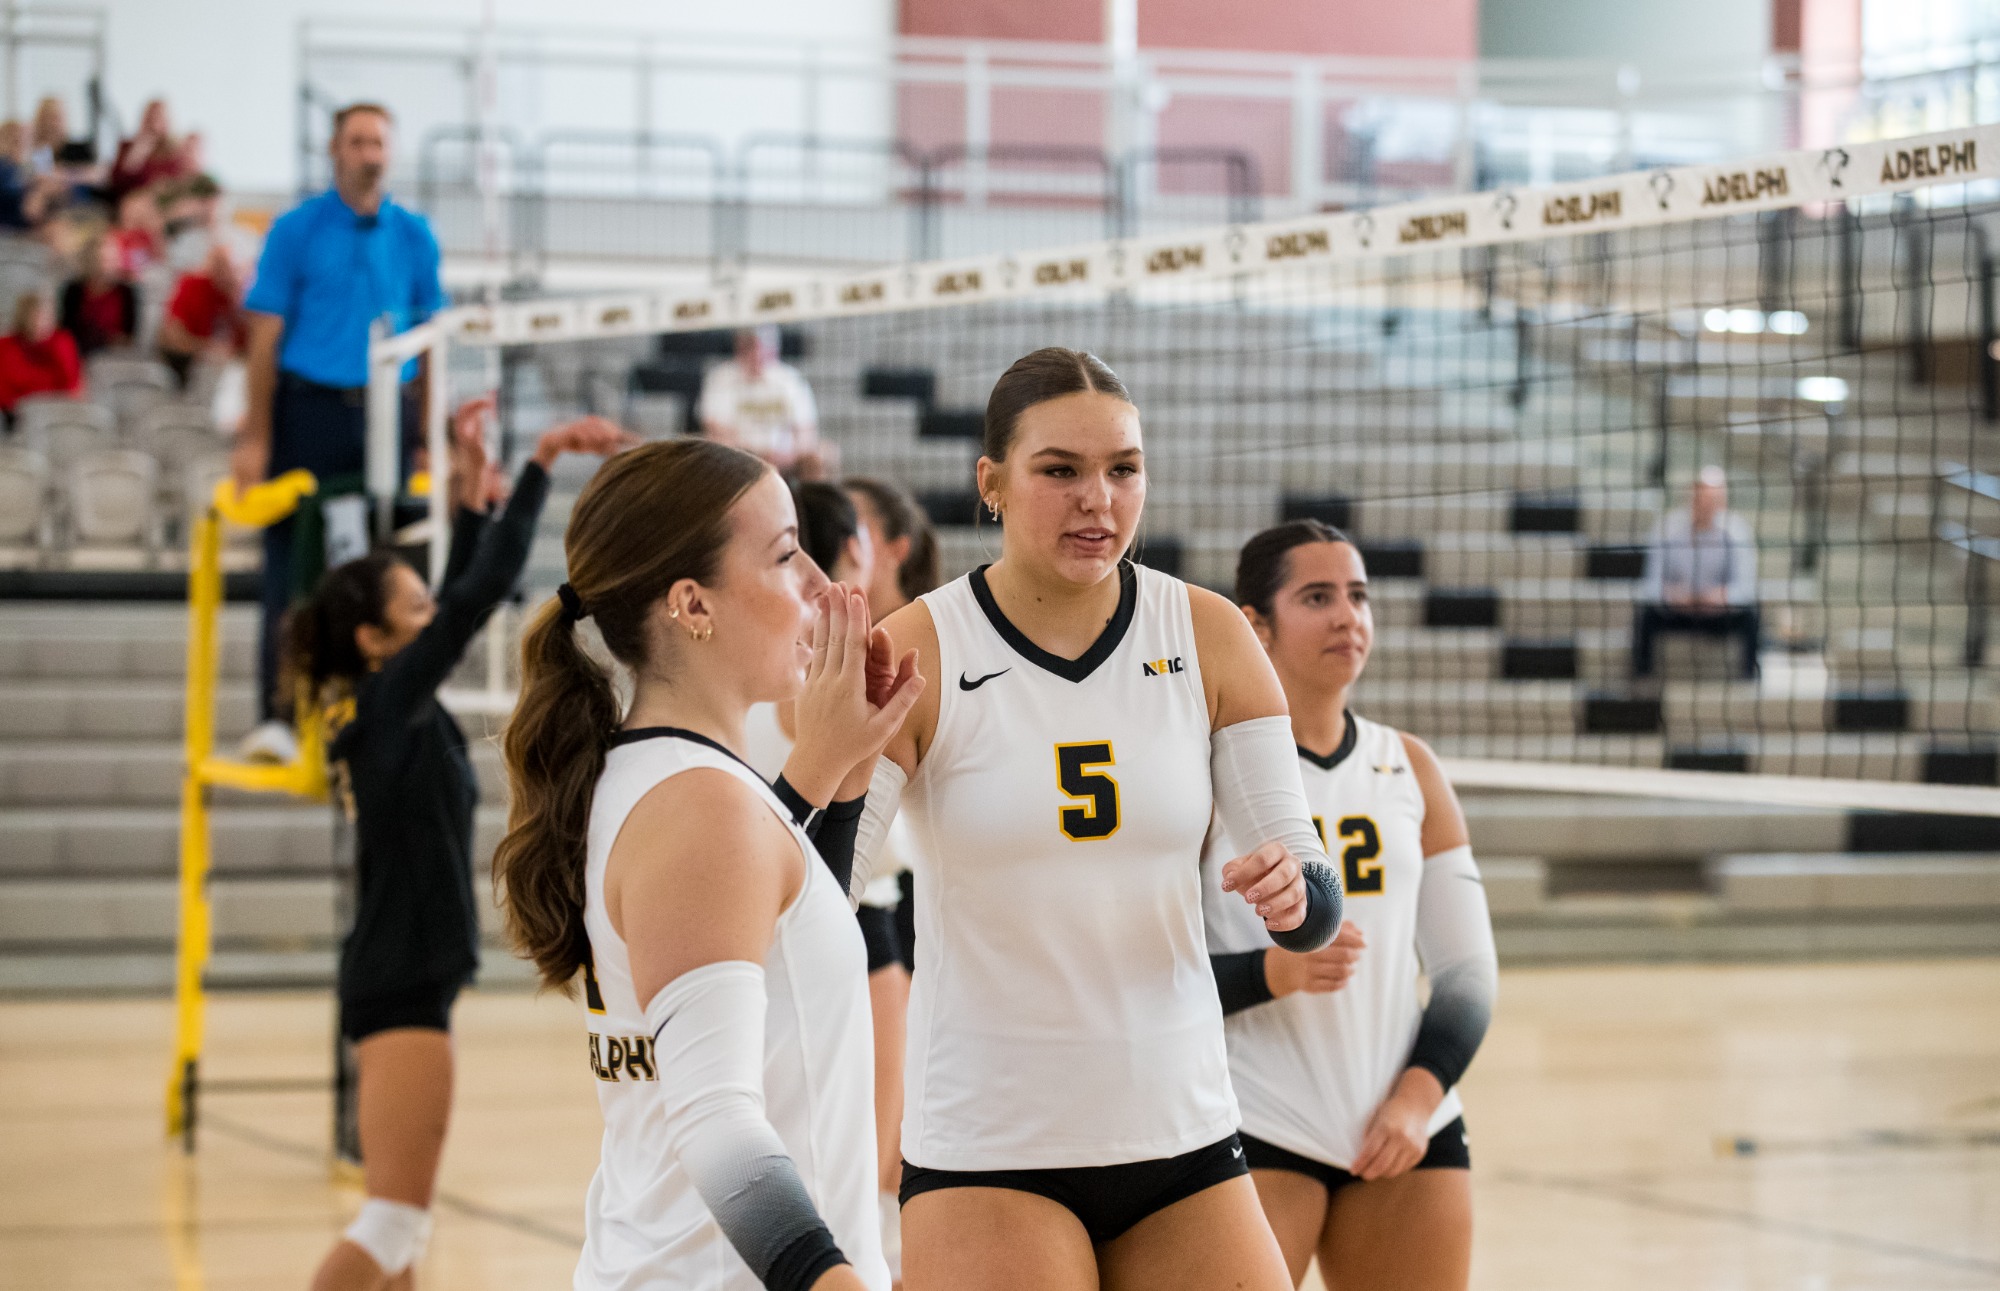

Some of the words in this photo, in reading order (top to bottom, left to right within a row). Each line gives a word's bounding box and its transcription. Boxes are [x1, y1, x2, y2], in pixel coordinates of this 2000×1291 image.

[1881, 140, 1977, 183] ADELPHI
[1702, 167, 1789, 205] ADELPHI
[1055, 741, 1121, 842] 5
